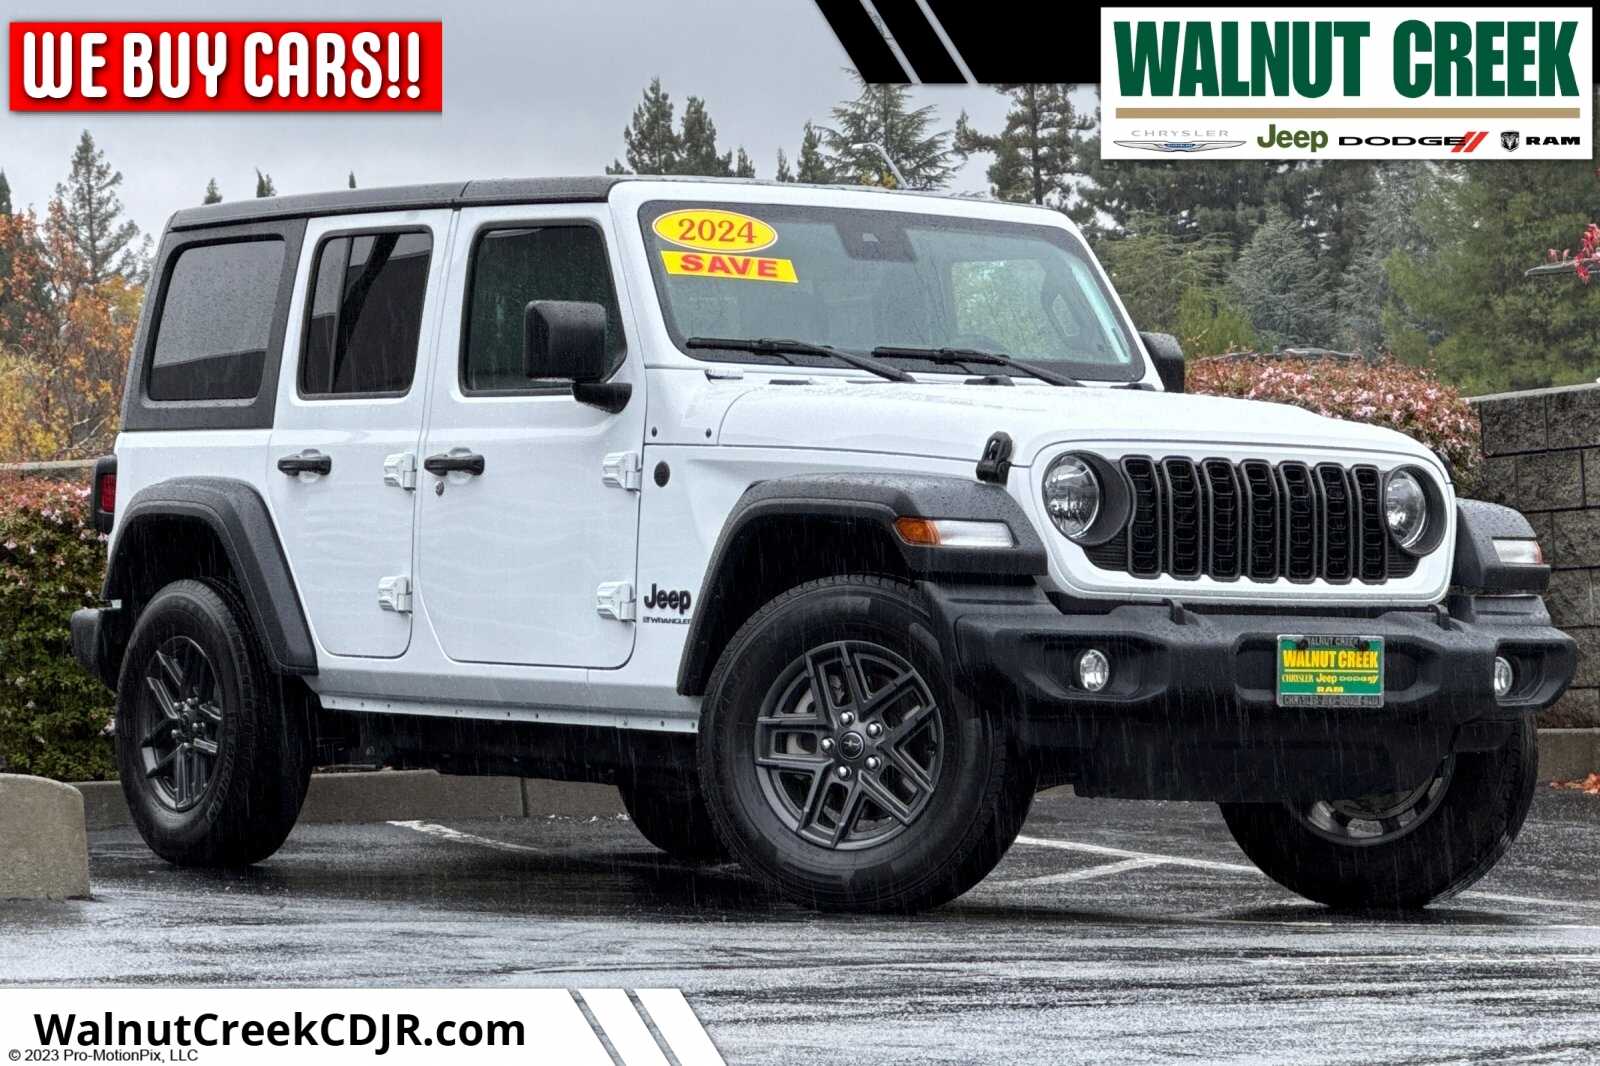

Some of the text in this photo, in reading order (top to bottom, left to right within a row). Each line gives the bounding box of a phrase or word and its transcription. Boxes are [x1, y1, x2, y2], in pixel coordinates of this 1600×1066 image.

[678, 218, 757, 243] 2024
[680, 254, 778, 278] SAVE
[643, 583, 691, 615] Jeep
[1283, 650, 1379, 668] WALNUT CREEK
[1316, 673, 1337, 684] Jeep
